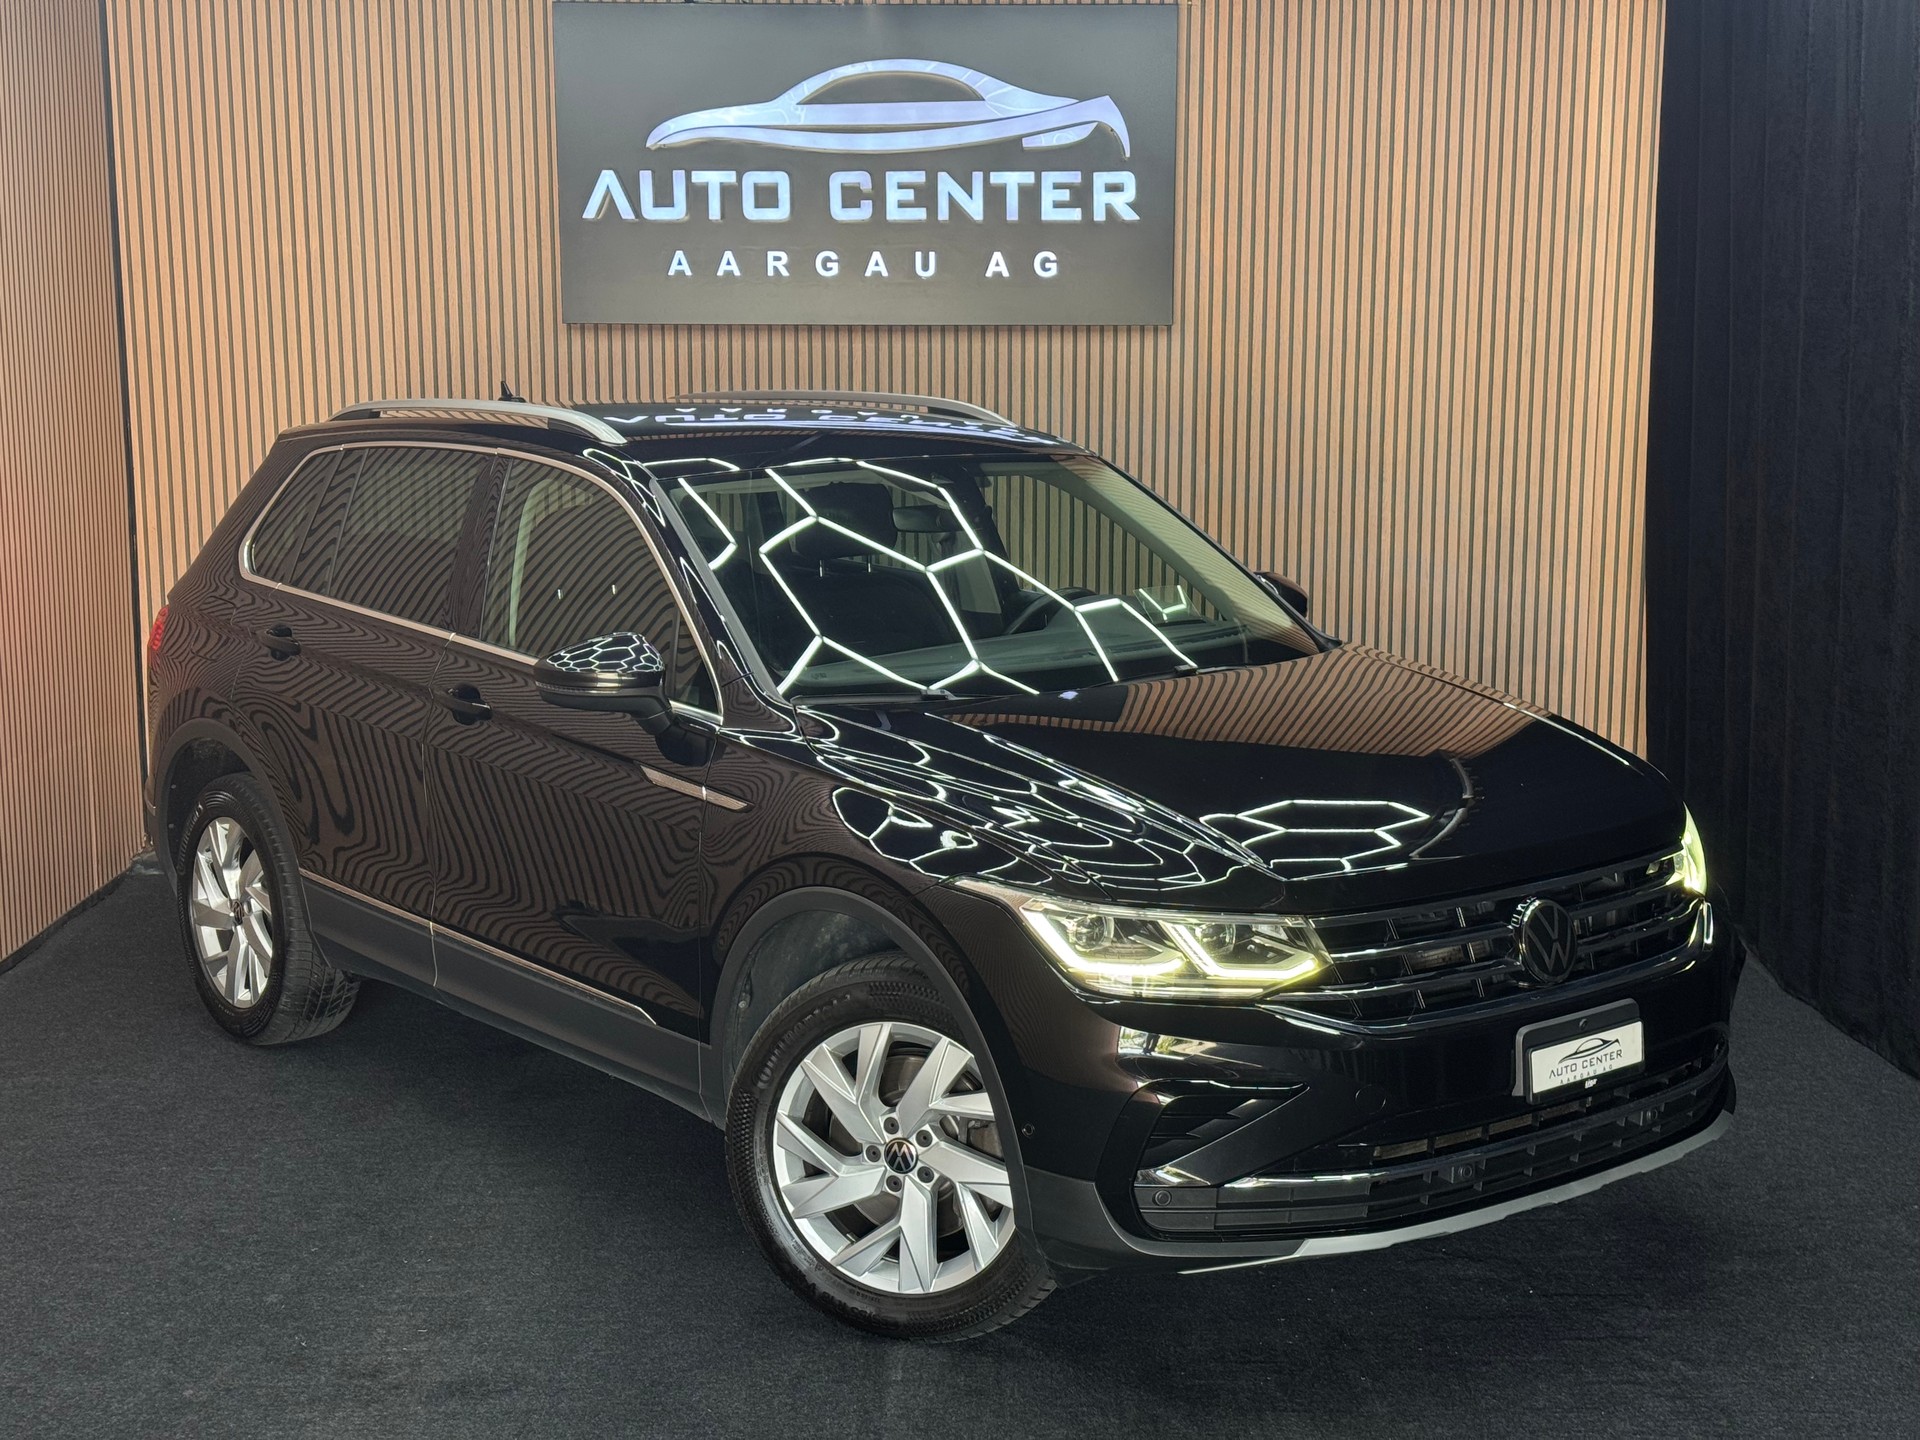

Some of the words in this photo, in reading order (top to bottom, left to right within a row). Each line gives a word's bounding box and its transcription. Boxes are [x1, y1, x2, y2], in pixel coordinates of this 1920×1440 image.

[582, 169, 791, 221] AUTO
[829, 170, 1141, 221] CENTER
[668, 250, 937, 278] AARGAU
[985, 250, 1059, 278] AG
[1549, 1063, 1578, 1079] AUTO
[1582, 1049, 1623, 1070] CENTER
